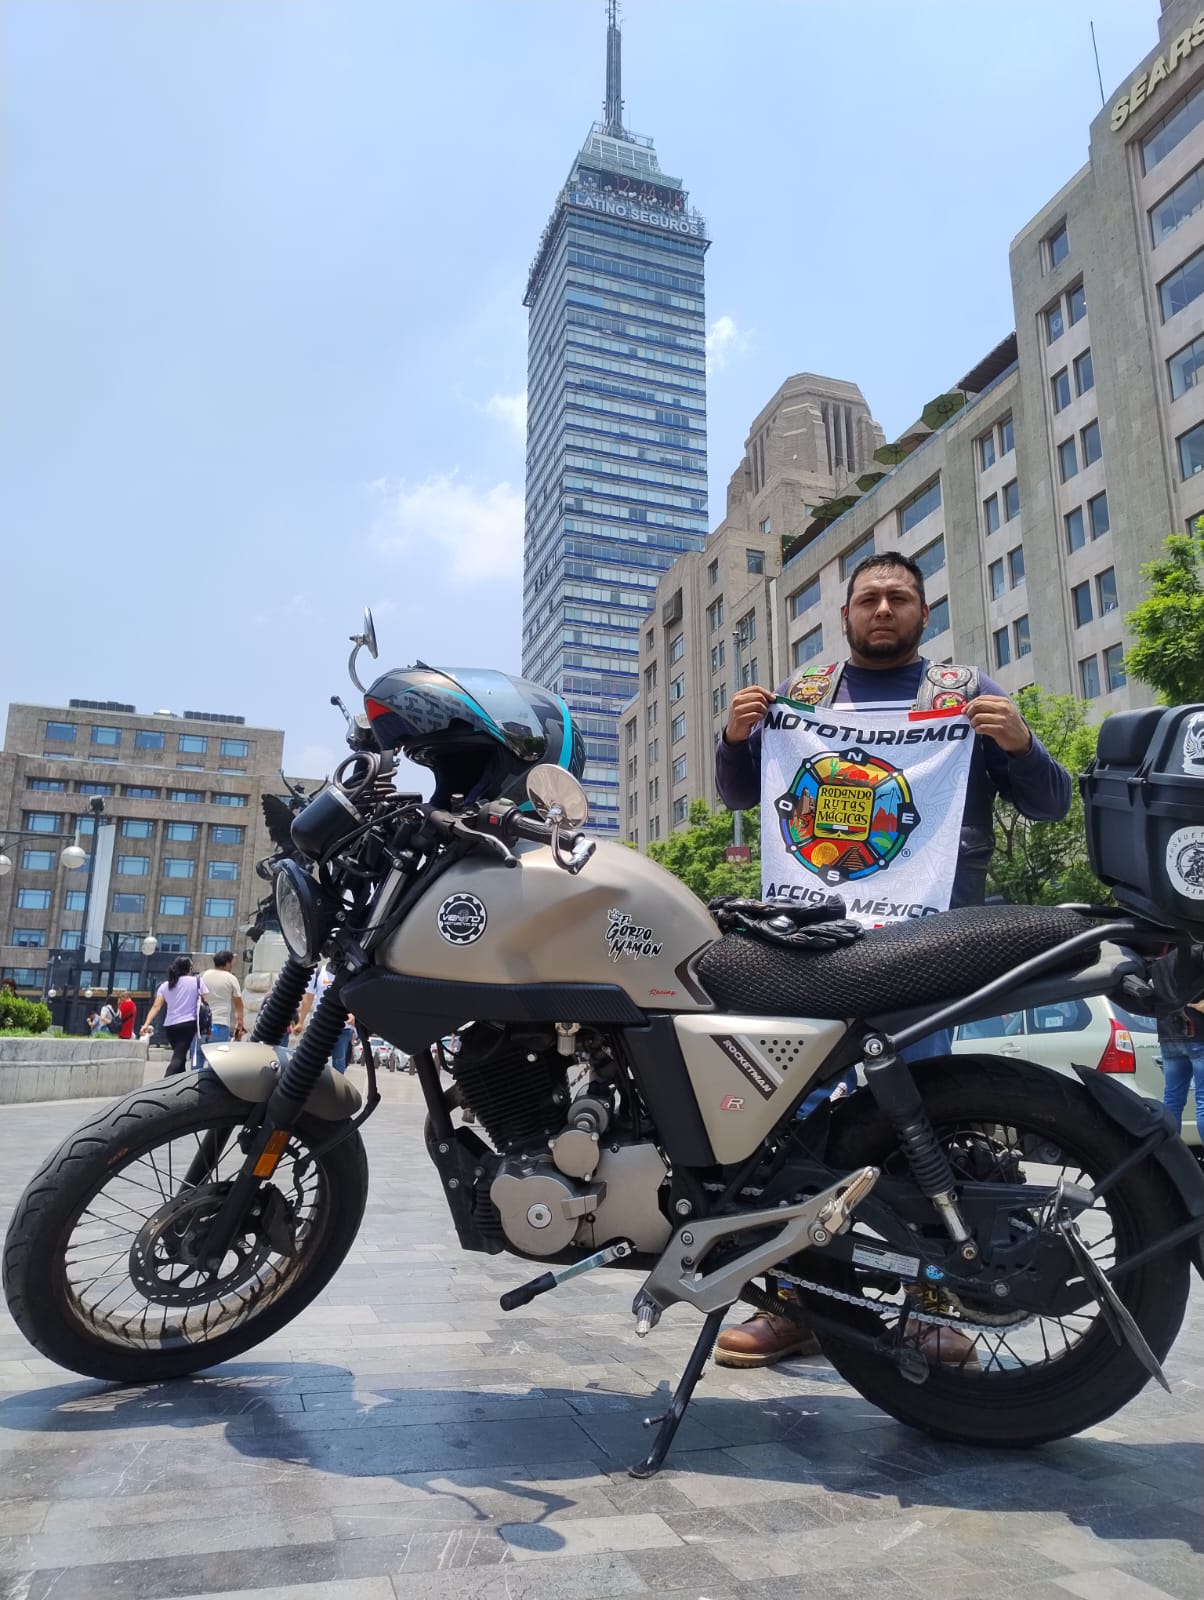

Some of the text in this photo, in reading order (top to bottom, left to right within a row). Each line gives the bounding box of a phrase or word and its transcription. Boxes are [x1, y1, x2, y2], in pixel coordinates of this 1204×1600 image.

[1110, 10, 1204, 132] SEARS
[575, 193, 699, 236] LATINO SEGUROS
[763, 711, 971, 746] MOTOTURISMO
[847, 752, 862, 762] N
[779, 800, 793, 812] O
[901, 812, 915, 825] E
[827, 870, 841, 881] S
[443, 914, 480, 922] VENTO
[606, 922, 652, 943] GORDO
[723, 1039, 772, 1093] ROCKETMAN
